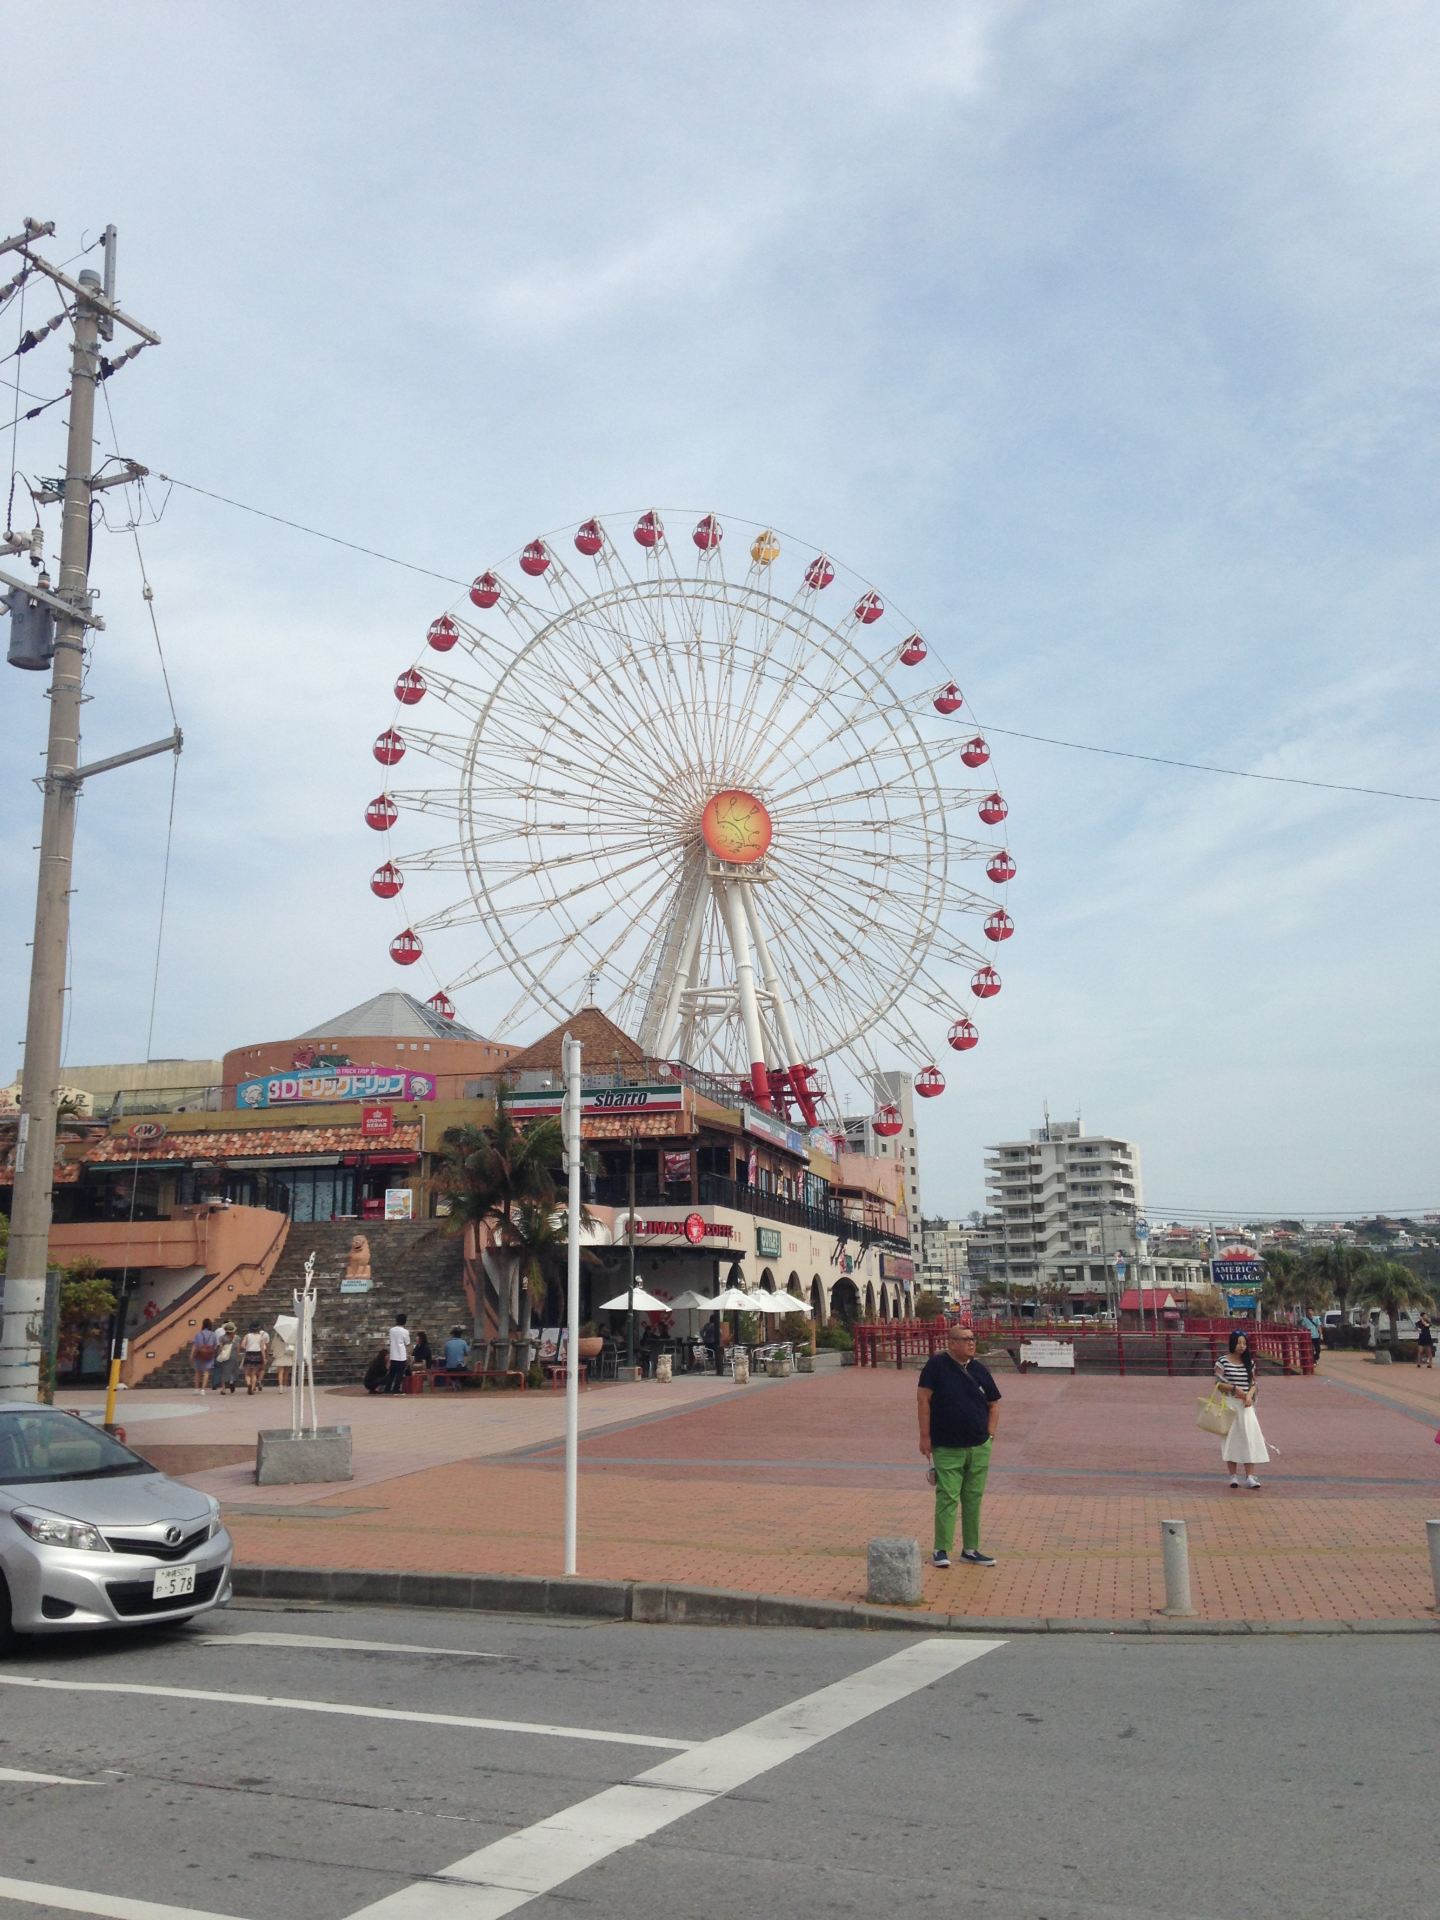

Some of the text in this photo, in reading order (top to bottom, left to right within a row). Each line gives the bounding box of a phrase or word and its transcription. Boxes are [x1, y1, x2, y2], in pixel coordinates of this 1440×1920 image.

[268, 1074, 406, 1099] 3Dトリックトリップ
[594, 1090, 648, 1107] sbarro
